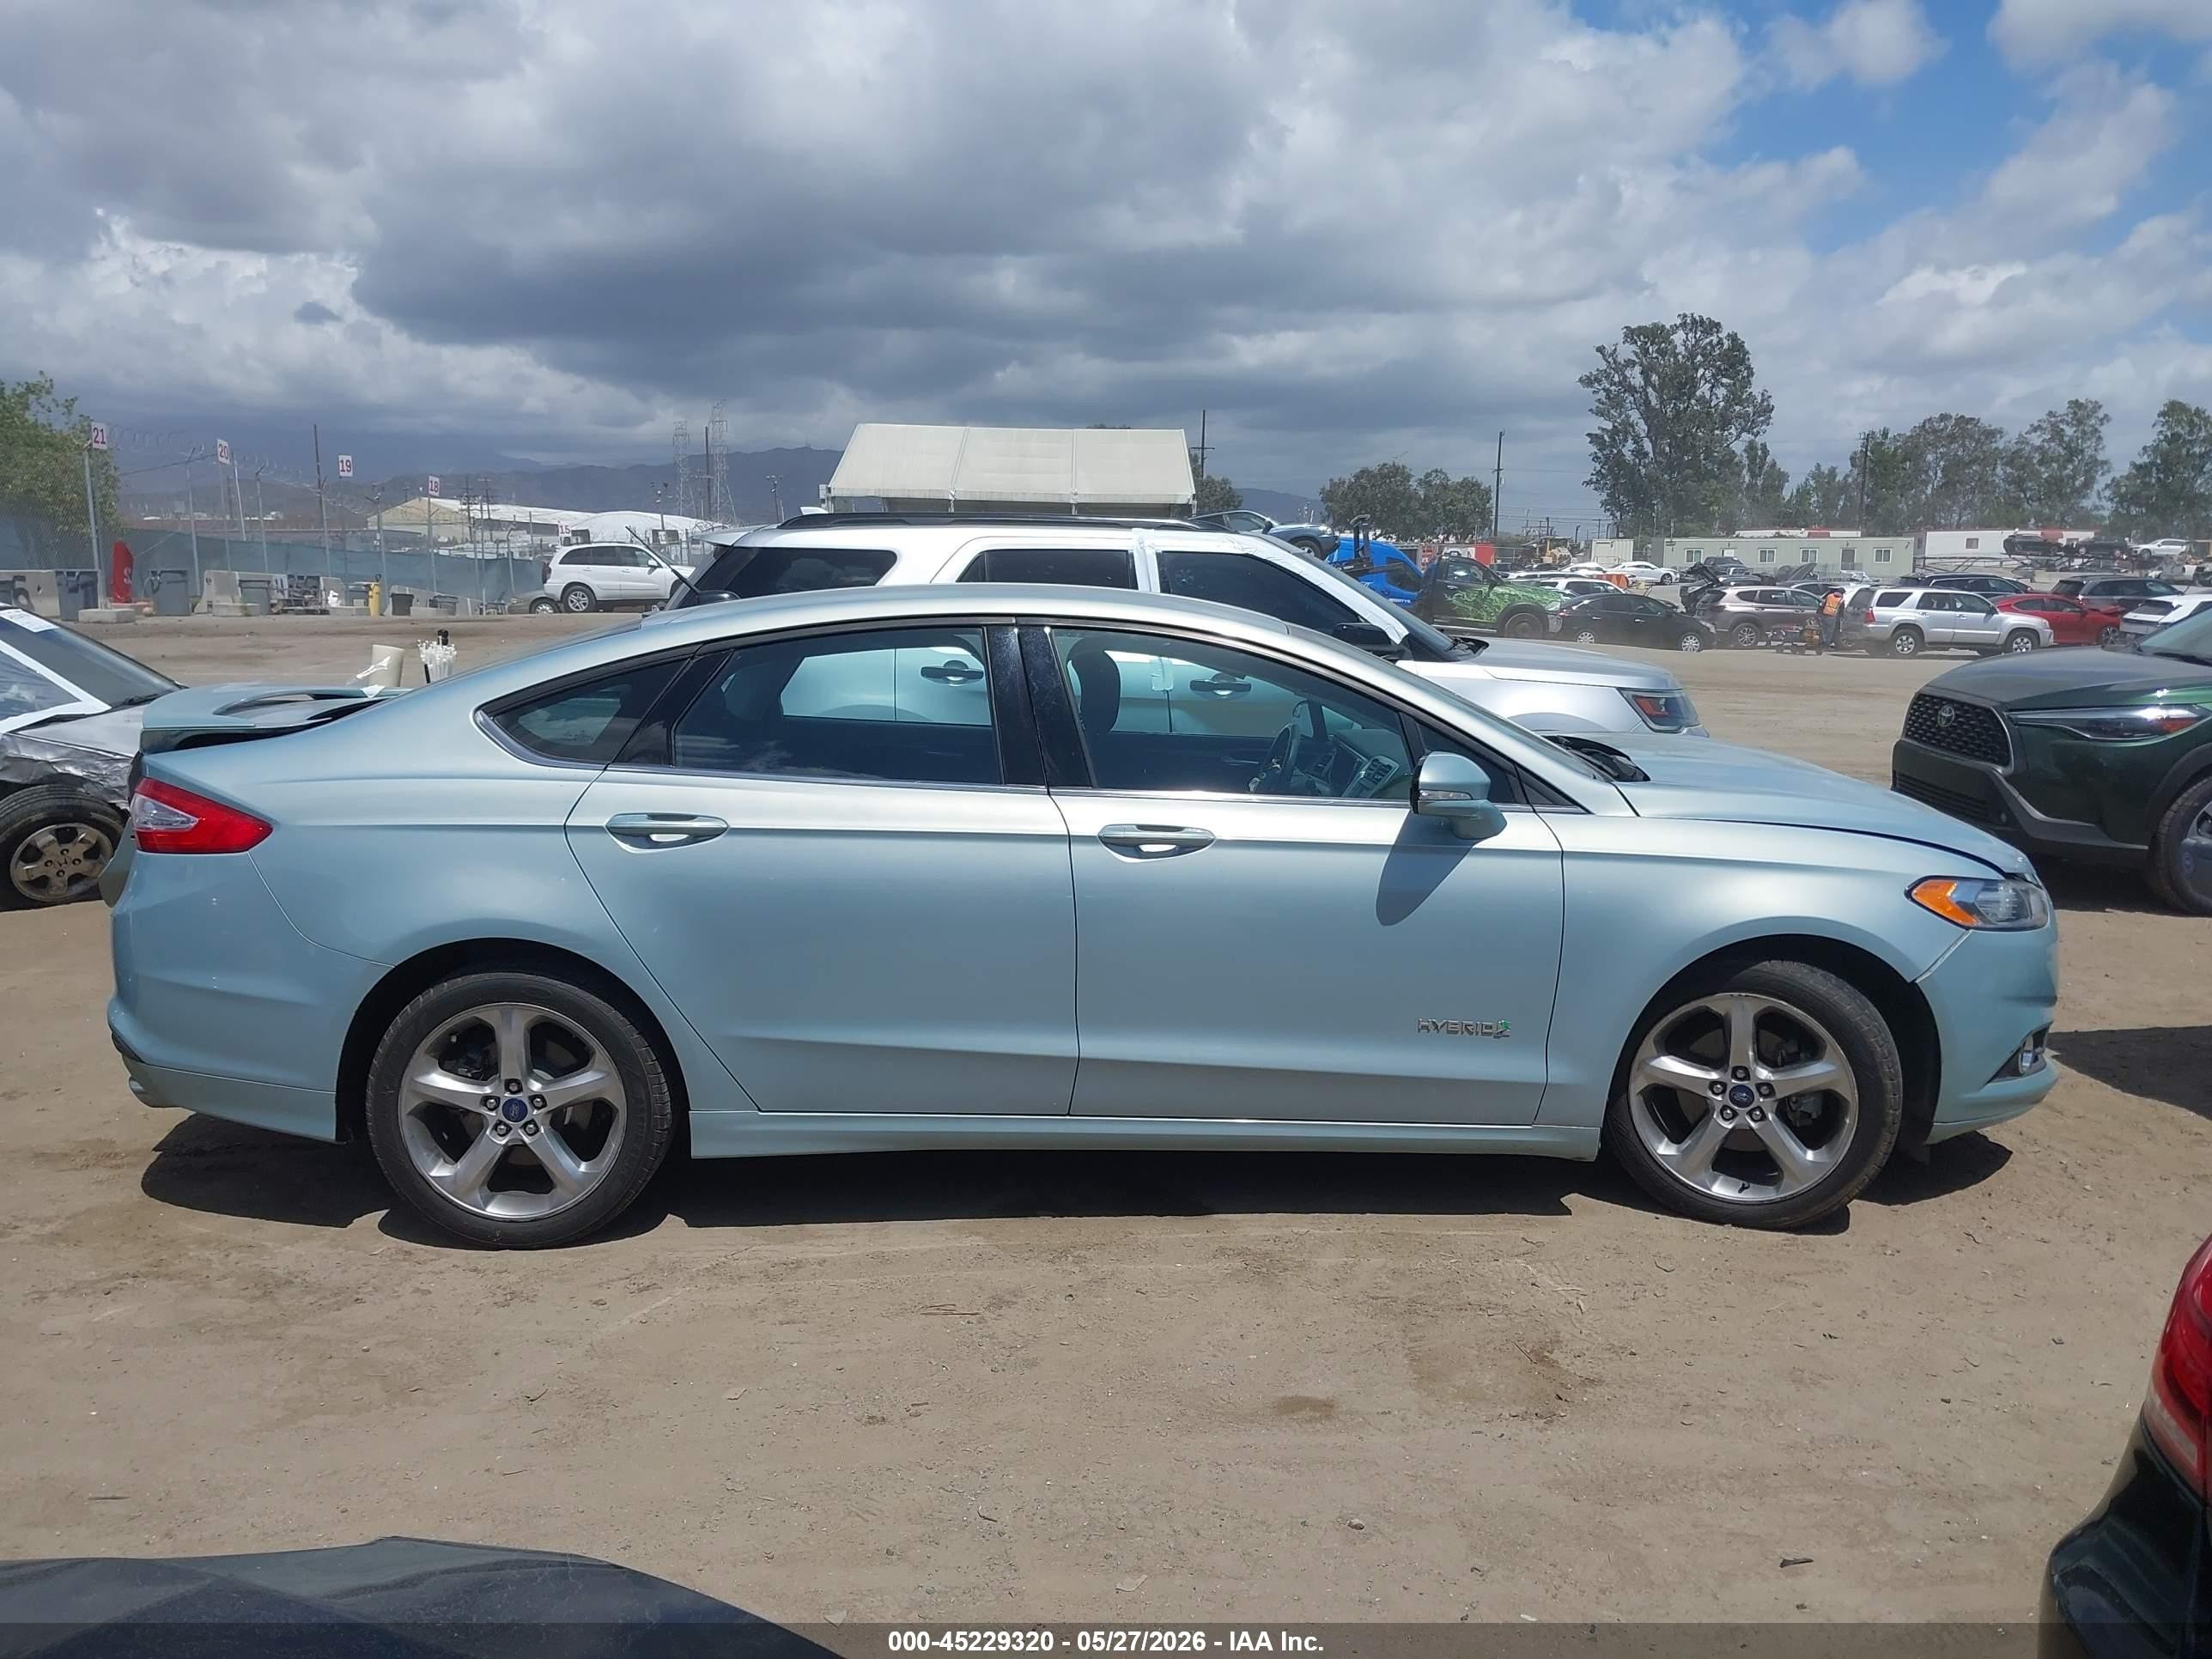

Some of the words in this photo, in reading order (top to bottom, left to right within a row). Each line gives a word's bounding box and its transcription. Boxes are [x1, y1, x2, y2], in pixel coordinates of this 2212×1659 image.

[93, 427, 106, 445] 21
[218, 444, 228, 460] 20
[340, 459, 352, 473] 19
[429, 480, 439, 493] 18
[559, 525, 571, 534] 15
[1417, 1018, 1494, 1036] HYBRID
